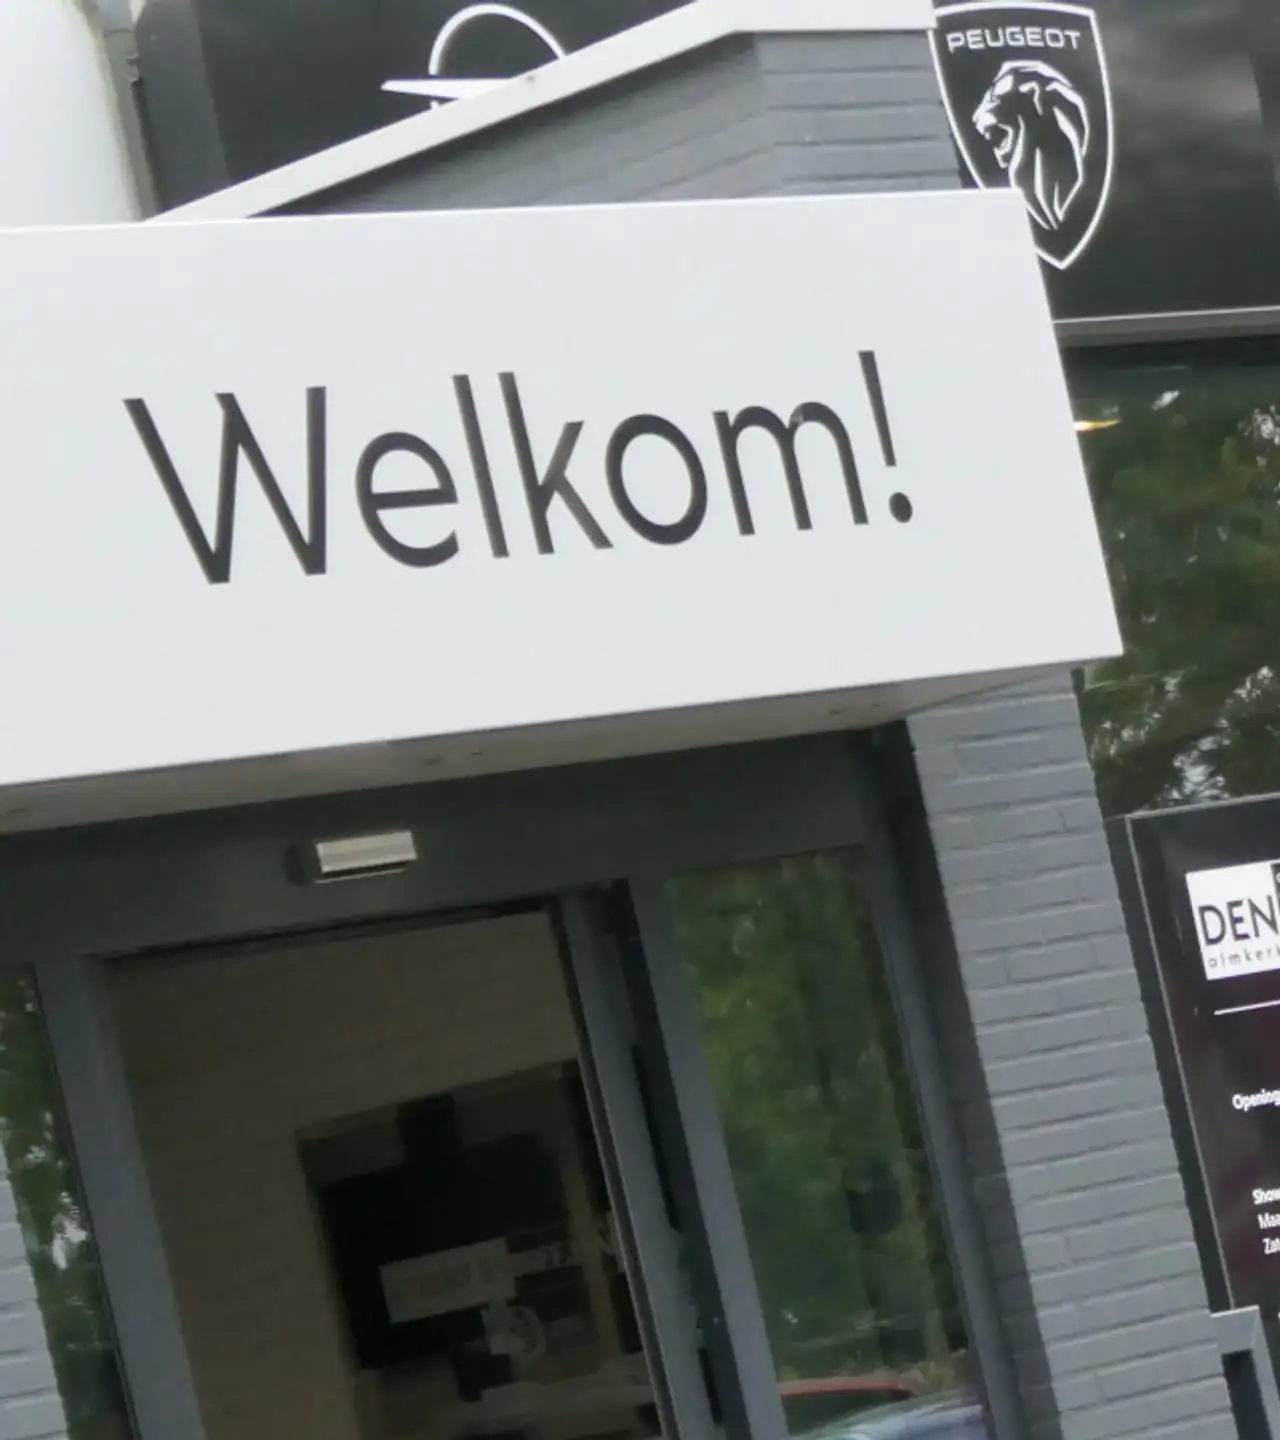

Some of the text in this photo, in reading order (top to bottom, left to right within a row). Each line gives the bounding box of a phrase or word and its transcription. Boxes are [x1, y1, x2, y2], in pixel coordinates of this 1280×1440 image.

[946, 26, 1082, 53] PEUGEOT
[124, 349, 914, 585] Welkom!
[1198, 895, 1280, 946] DEN
